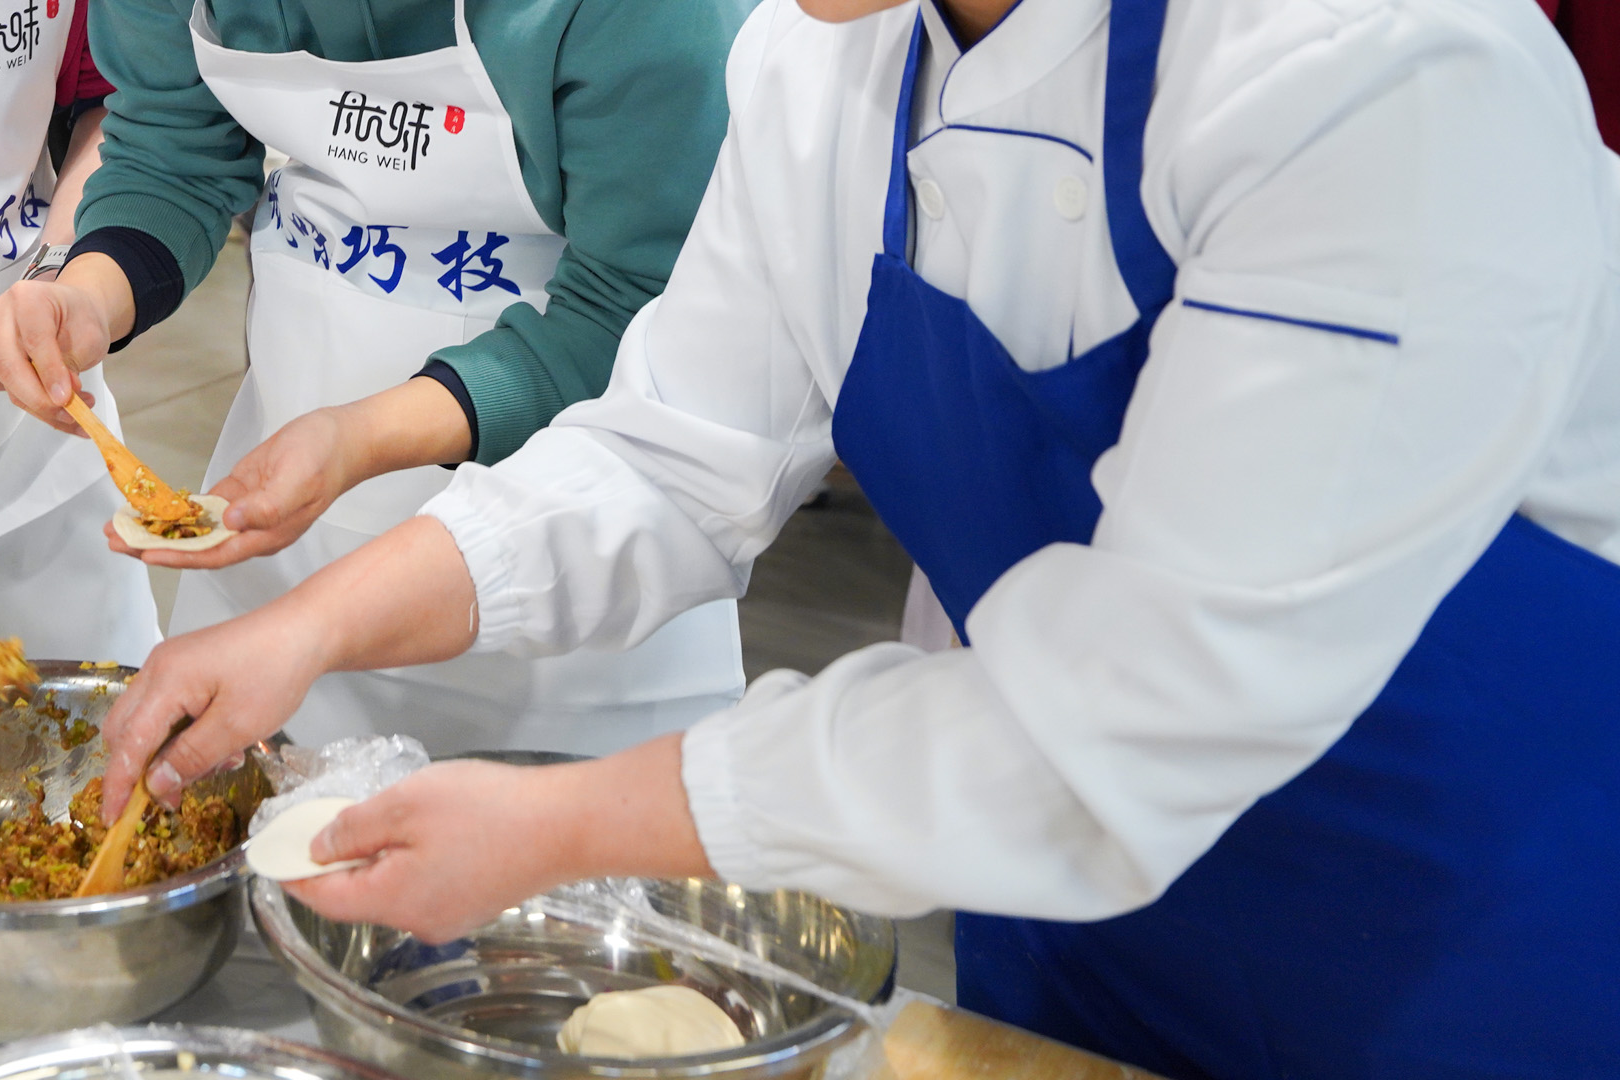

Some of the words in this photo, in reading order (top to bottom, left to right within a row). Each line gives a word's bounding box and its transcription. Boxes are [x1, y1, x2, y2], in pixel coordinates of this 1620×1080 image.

[6, 55, 27, 70] WEI
[327, 144, 369, 164] HANG
[376, 154, 406, 171] WEI
